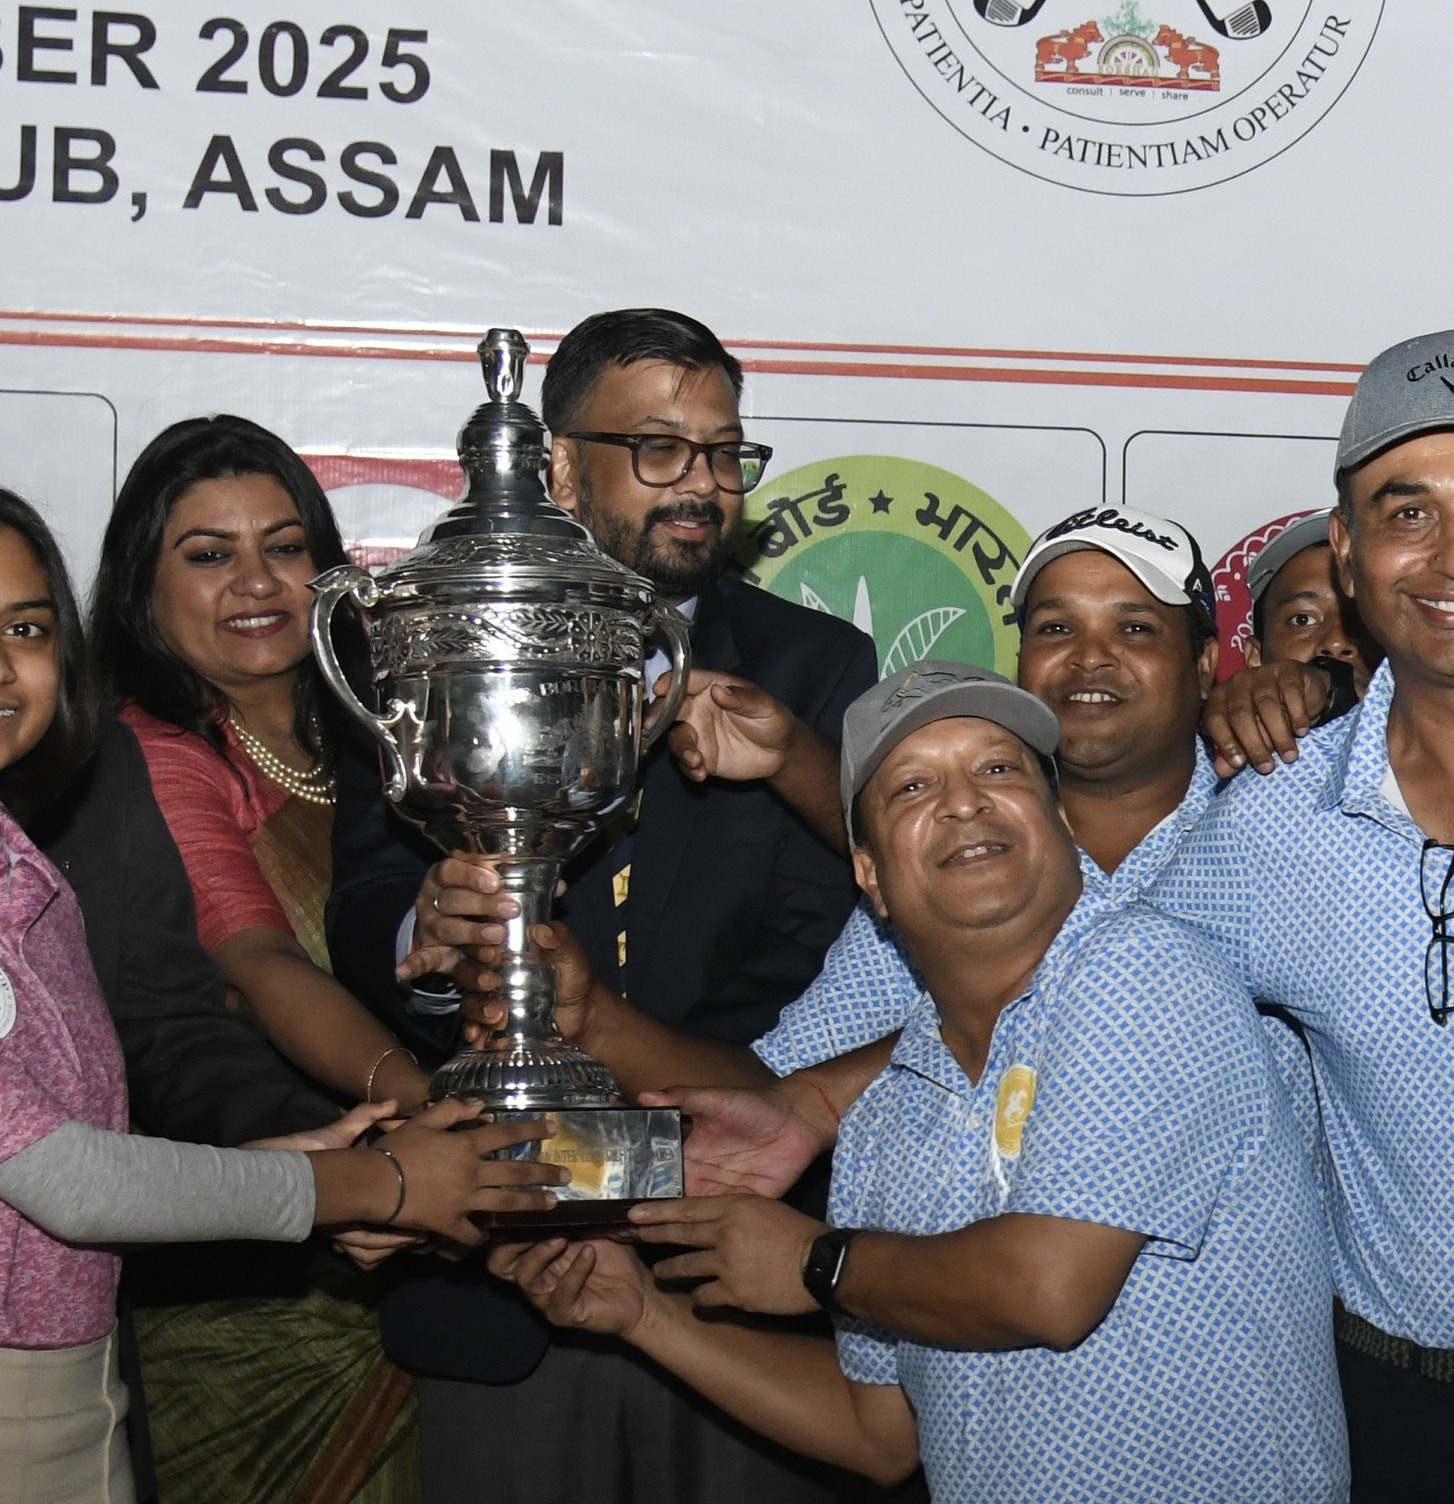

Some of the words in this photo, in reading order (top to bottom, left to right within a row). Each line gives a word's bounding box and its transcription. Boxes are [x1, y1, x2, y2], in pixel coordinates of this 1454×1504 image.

[195, 17, 432, 104] 2025
[901, 0, 1012, 131] PATIENTIA
[1038, 126, 1231, 169] PATIENTIAM
[1232, 14, 1352, 142] OPERATUR
[1066, 86, 1103, 97] consult
[1118, 88, 1146, 98] serve
[1161, 90, 1189, 101] share
[182, 134, 565, 227] ASSAM
